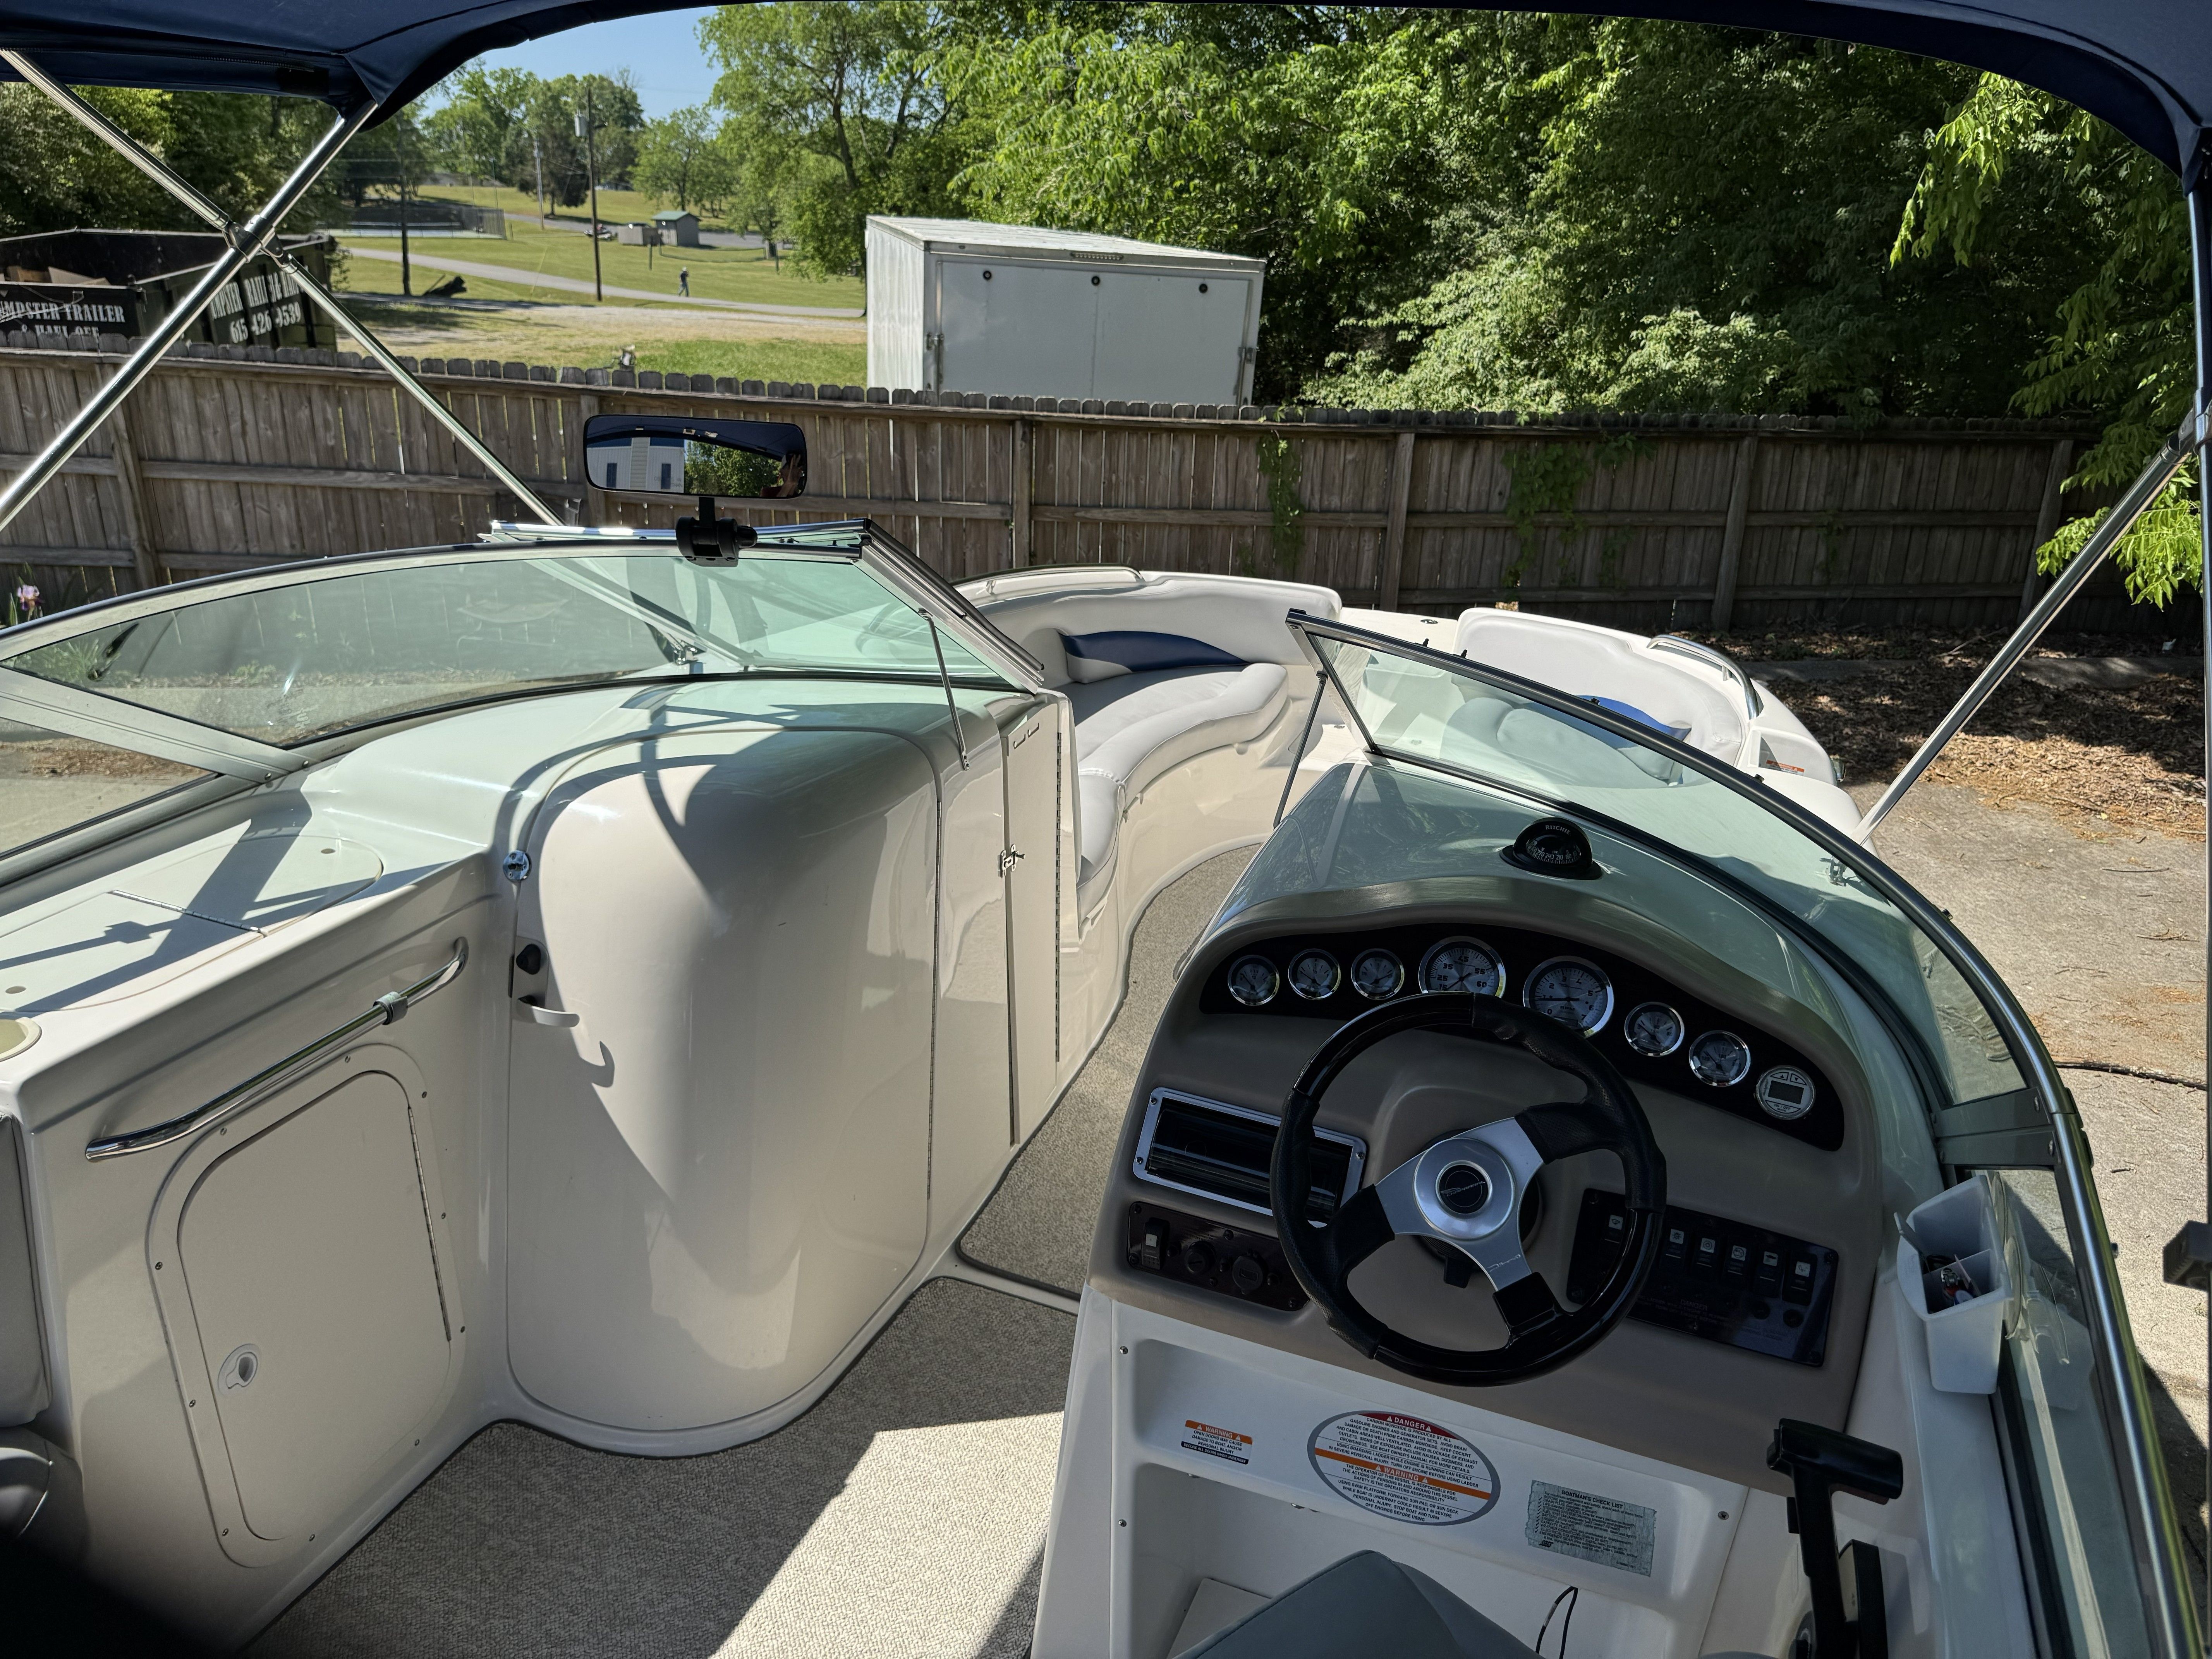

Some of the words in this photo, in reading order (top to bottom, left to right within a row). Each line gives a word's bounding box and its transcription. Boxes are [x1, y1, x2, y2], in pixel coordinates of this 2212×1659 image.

[64, 304, 125, 323] TRAILER
[230, 318, 248, 343] 615
[251, 310, 272, 336] 426
[1545, 825, 1571, 835] RITCHIE
[1350, 1419, 1370, 1427] GASOLINE
[1400, 1431, 1425, 1441] GENERATOR
[1385, 1422, 1406, 1431] MONOXIDE
[1412, 1429, 1436, 1438] PRODUCED
[1394, 1417, 1425, 1430] DANGER
[1204, 1426, 1233, 1438] WARNING
[1198, 1441, 1218, 1450] PERSONAL
[1380, 1442, 1402, 1451] EXPOSURE
[1403, 1448, 1421, 1456] INCLUDE
[1350, 1446, 1372, 1455] BOARDING
[1425, 1465, 1446, 1474] RUNNING
[1427, 1449, 1450, 1458] BLOCKAGE
[1458, 1456, 1477, 1465] EXHAUST
[1350, 1451, 1373, 1460] PERSONAL
[1429, 1471, 1446, 1479] BEFORE
[1461, 1479, 1479, 1487] LADDER
[1354, 1466, 1377, 1475] OPERATOR
[1383, 1467, 1419, 1481] WARNING
[1353, 1494, 1376, 1503] PERSONAL
[1387, 1492, 1408, 1501] FORWARD
[1561, 1489, 1592, 1501] BOATMAN'S
[1592, 1497, 1610, 1506] CHECK
[1374, 1505, 1393, 1513] ENGINES
